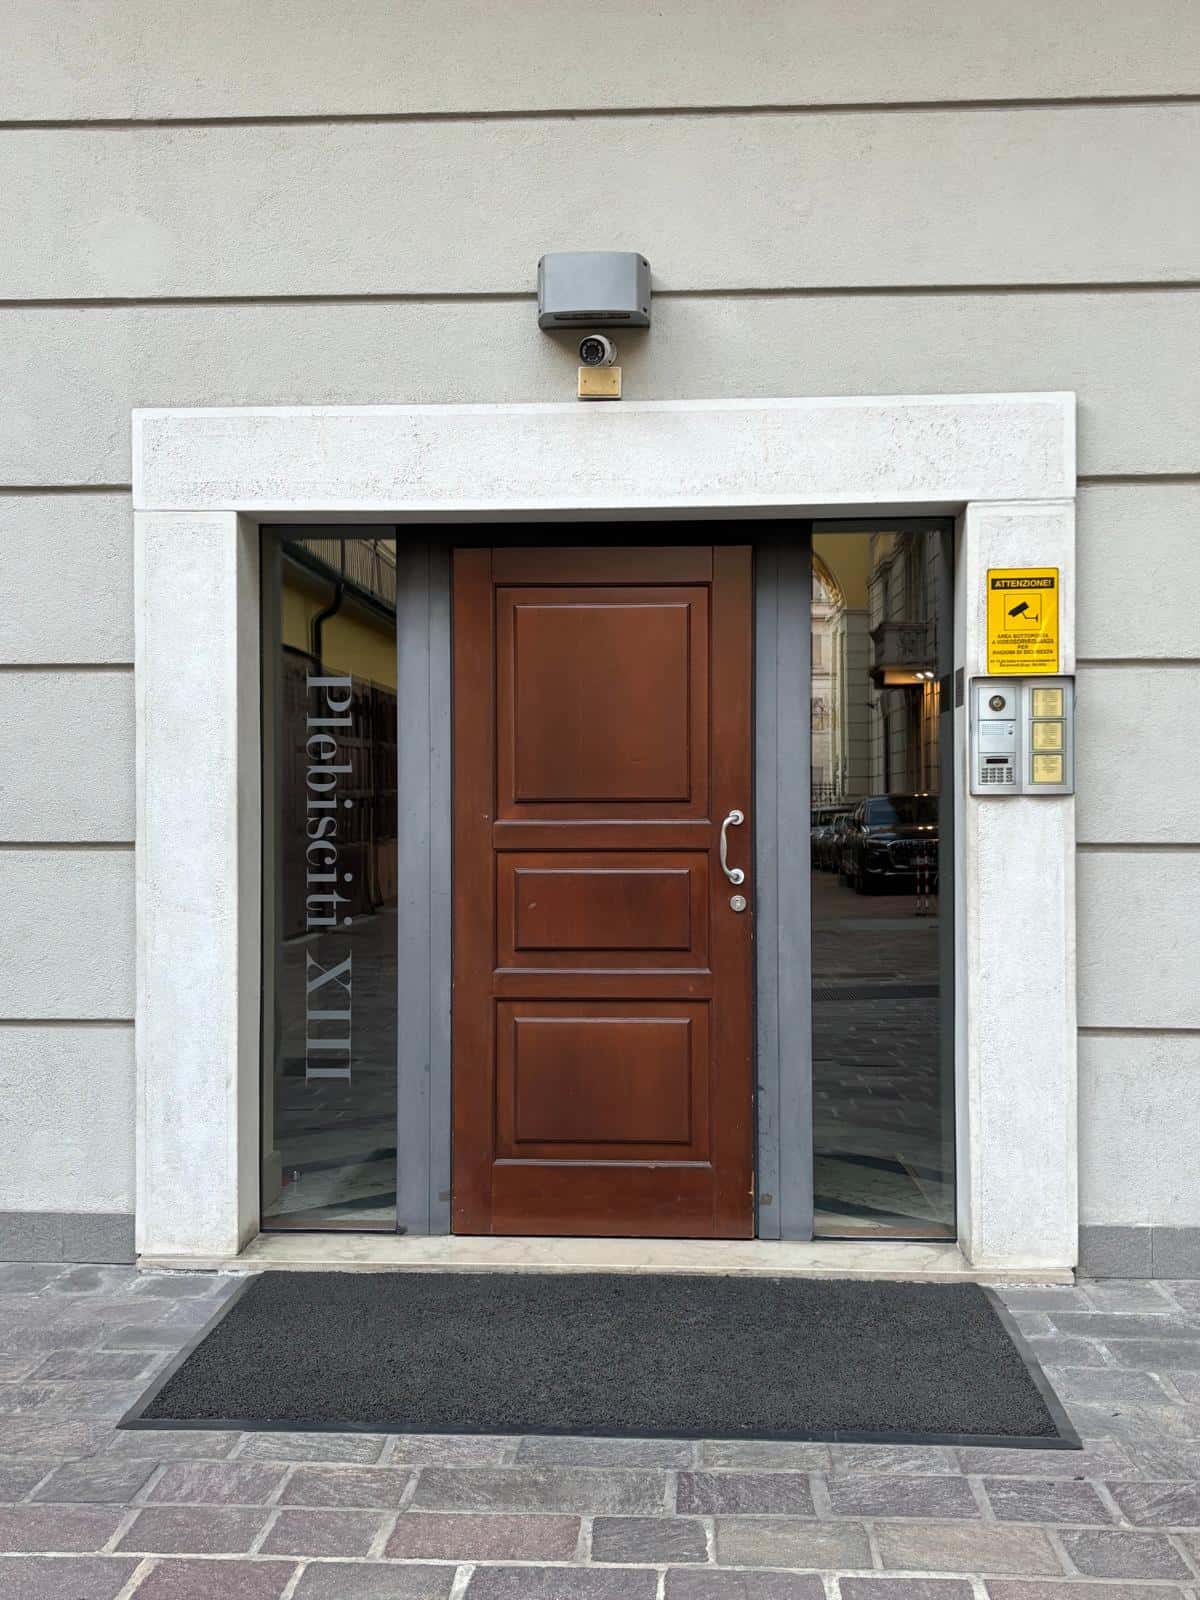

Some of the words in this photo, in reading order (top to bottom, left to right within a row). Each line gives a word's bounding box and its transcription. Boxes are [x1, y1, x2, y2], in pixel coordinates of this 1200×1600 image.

[994, 579, 1053, 588] ATTENZIONE!
[305, 667, 353, 932] Plebisciti
[304, 948, 352, 1089] XIII
